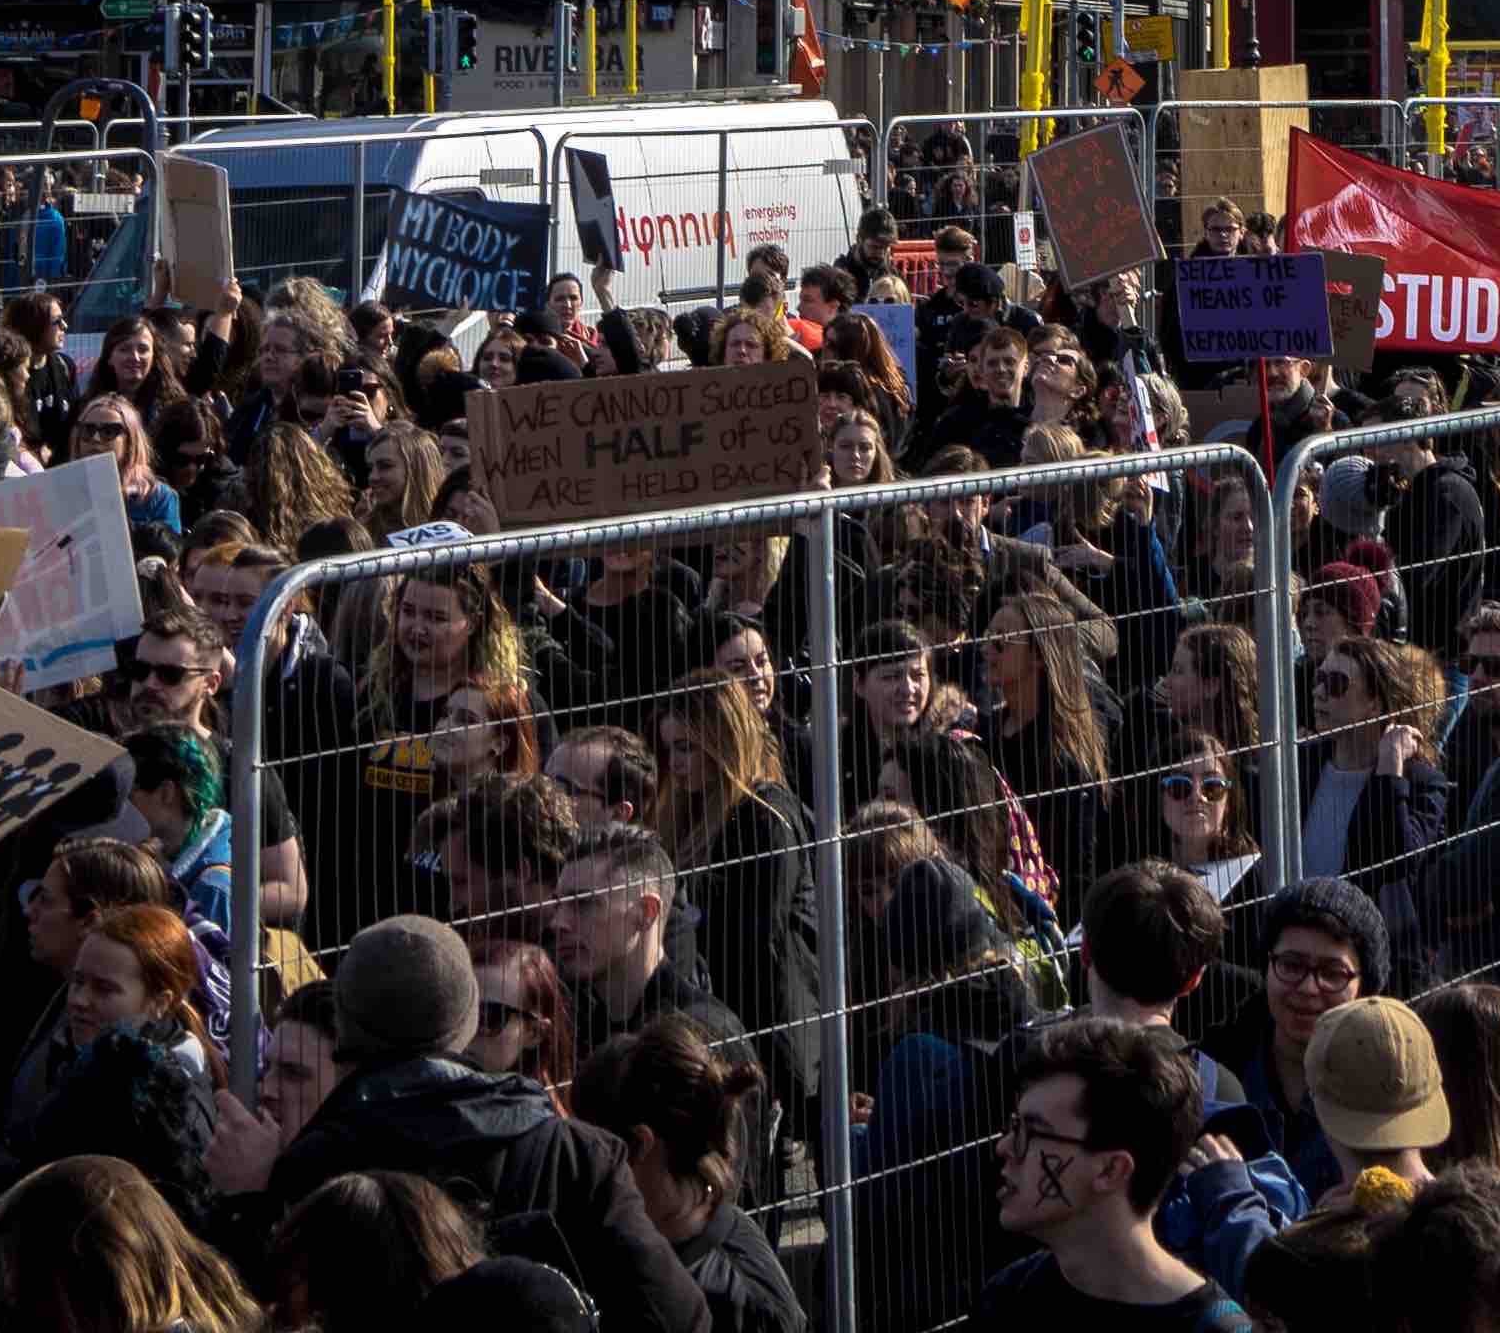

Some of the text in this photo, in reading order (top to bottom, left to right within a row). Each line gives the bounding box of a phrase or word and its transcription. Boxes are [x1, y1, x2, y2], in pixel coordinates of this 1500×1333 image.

[494, 44, 580, 72] RIVE
[743, 203, 798, 223] energising
[399, 196, 523, 270] MY BODY
[747, 226, 791, 244] mobility
[386, 244, 532, 313] MY CHOICE
[1179, 253, 1297, 281] SEIZE THE
[1189, 284, 1288, 310] MEANS OF
[1186, 329, 1318, 353] REPRODUCTION
[501, 376, 811, 434] WE CANNOT SUCCEED
[480, 436, 563, 483] WHEN
[583, 422, 704, 468] HALF
[526, 477, 598, 511] ARE
[620, 470, 700, 503] HELD
